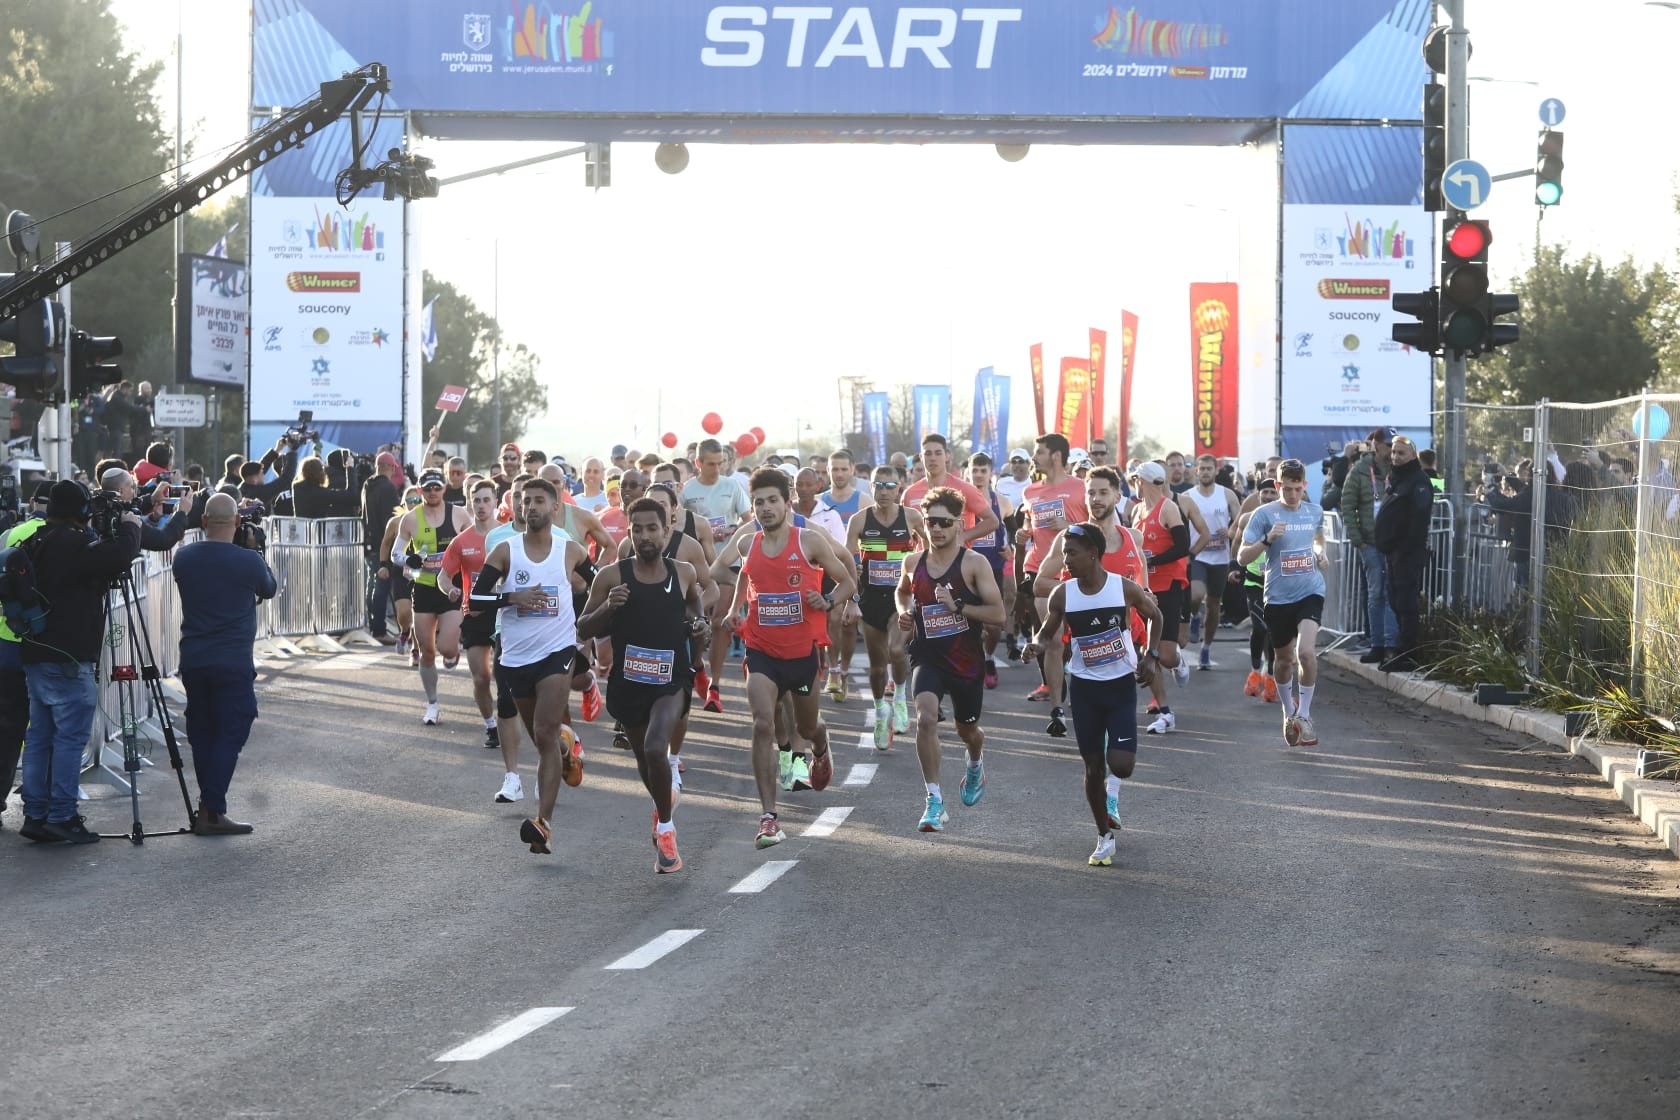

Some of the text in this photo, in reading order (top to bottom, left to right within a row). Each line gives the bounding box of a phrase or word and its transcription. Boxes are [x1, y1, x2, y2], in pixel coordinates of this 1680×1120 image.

[700, 6, 1022, 69] START
[449, 62, 493, 73] בירושלים
[1082, 64, 1113, 76] 2024
[1116, 62, 1168, 77] ירושלים
[1209, 66, 1248, 80] מרתון
[302, 274, 357, 288] Winner
[1332, 282, 1387, 295] Winner
[298, 304, 351, 315] saucony
[1329, 311, 1381, 322] saucony
[208, 320, 238, 334] כל החיים
[1198, 330, 1224, 449] Winner
[632, 660, 659, 673] 23922
